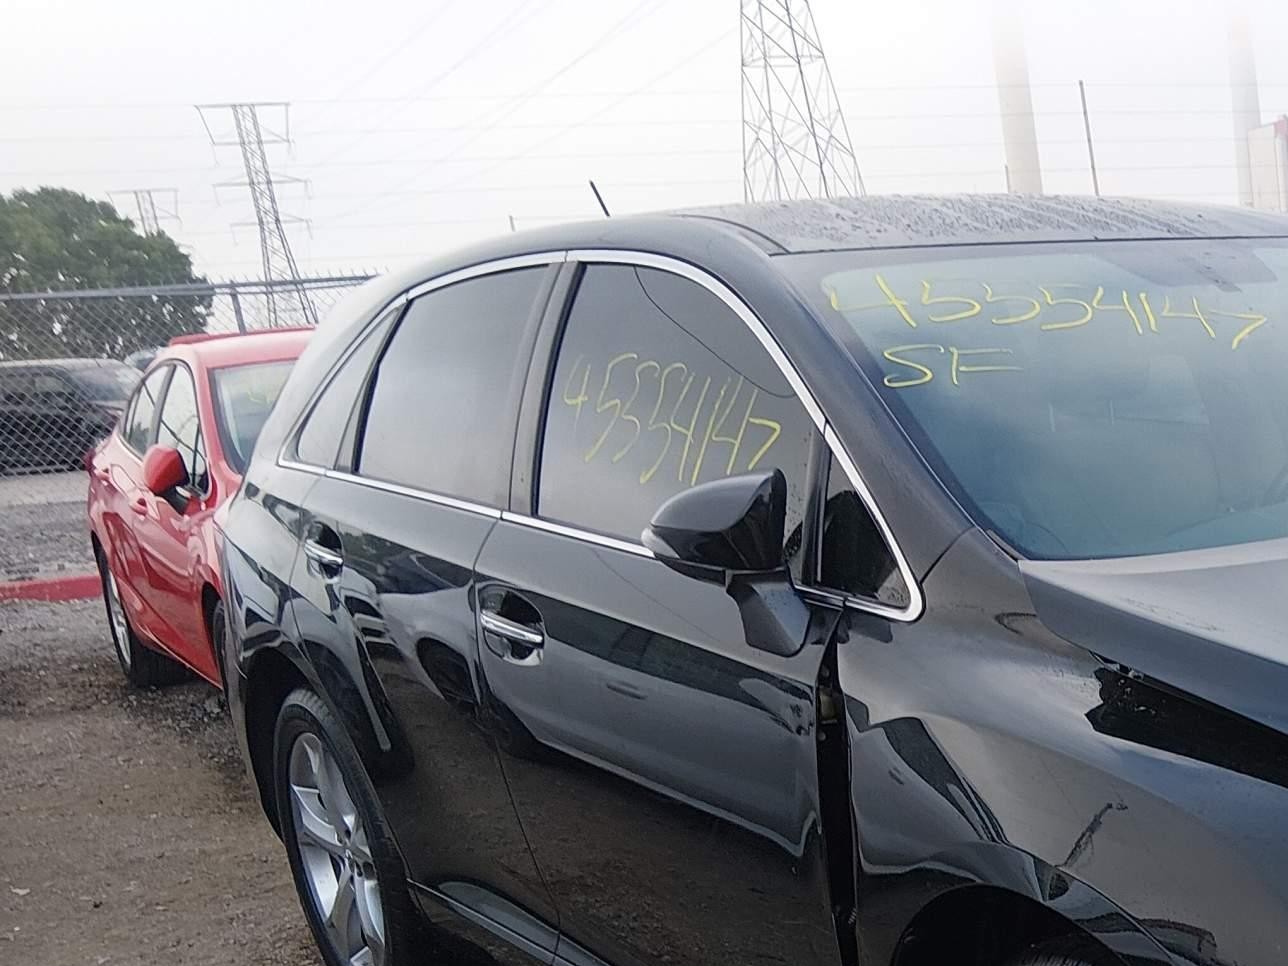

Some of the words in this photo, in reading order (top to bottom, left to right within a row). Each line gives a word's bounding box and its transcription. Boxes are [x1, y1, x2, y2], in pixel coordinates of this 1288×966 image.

[829, 274, 1266, 349] 45554147
[883, 344, 1020, 388] SF
[563, 354, 781, 485] 45554147
